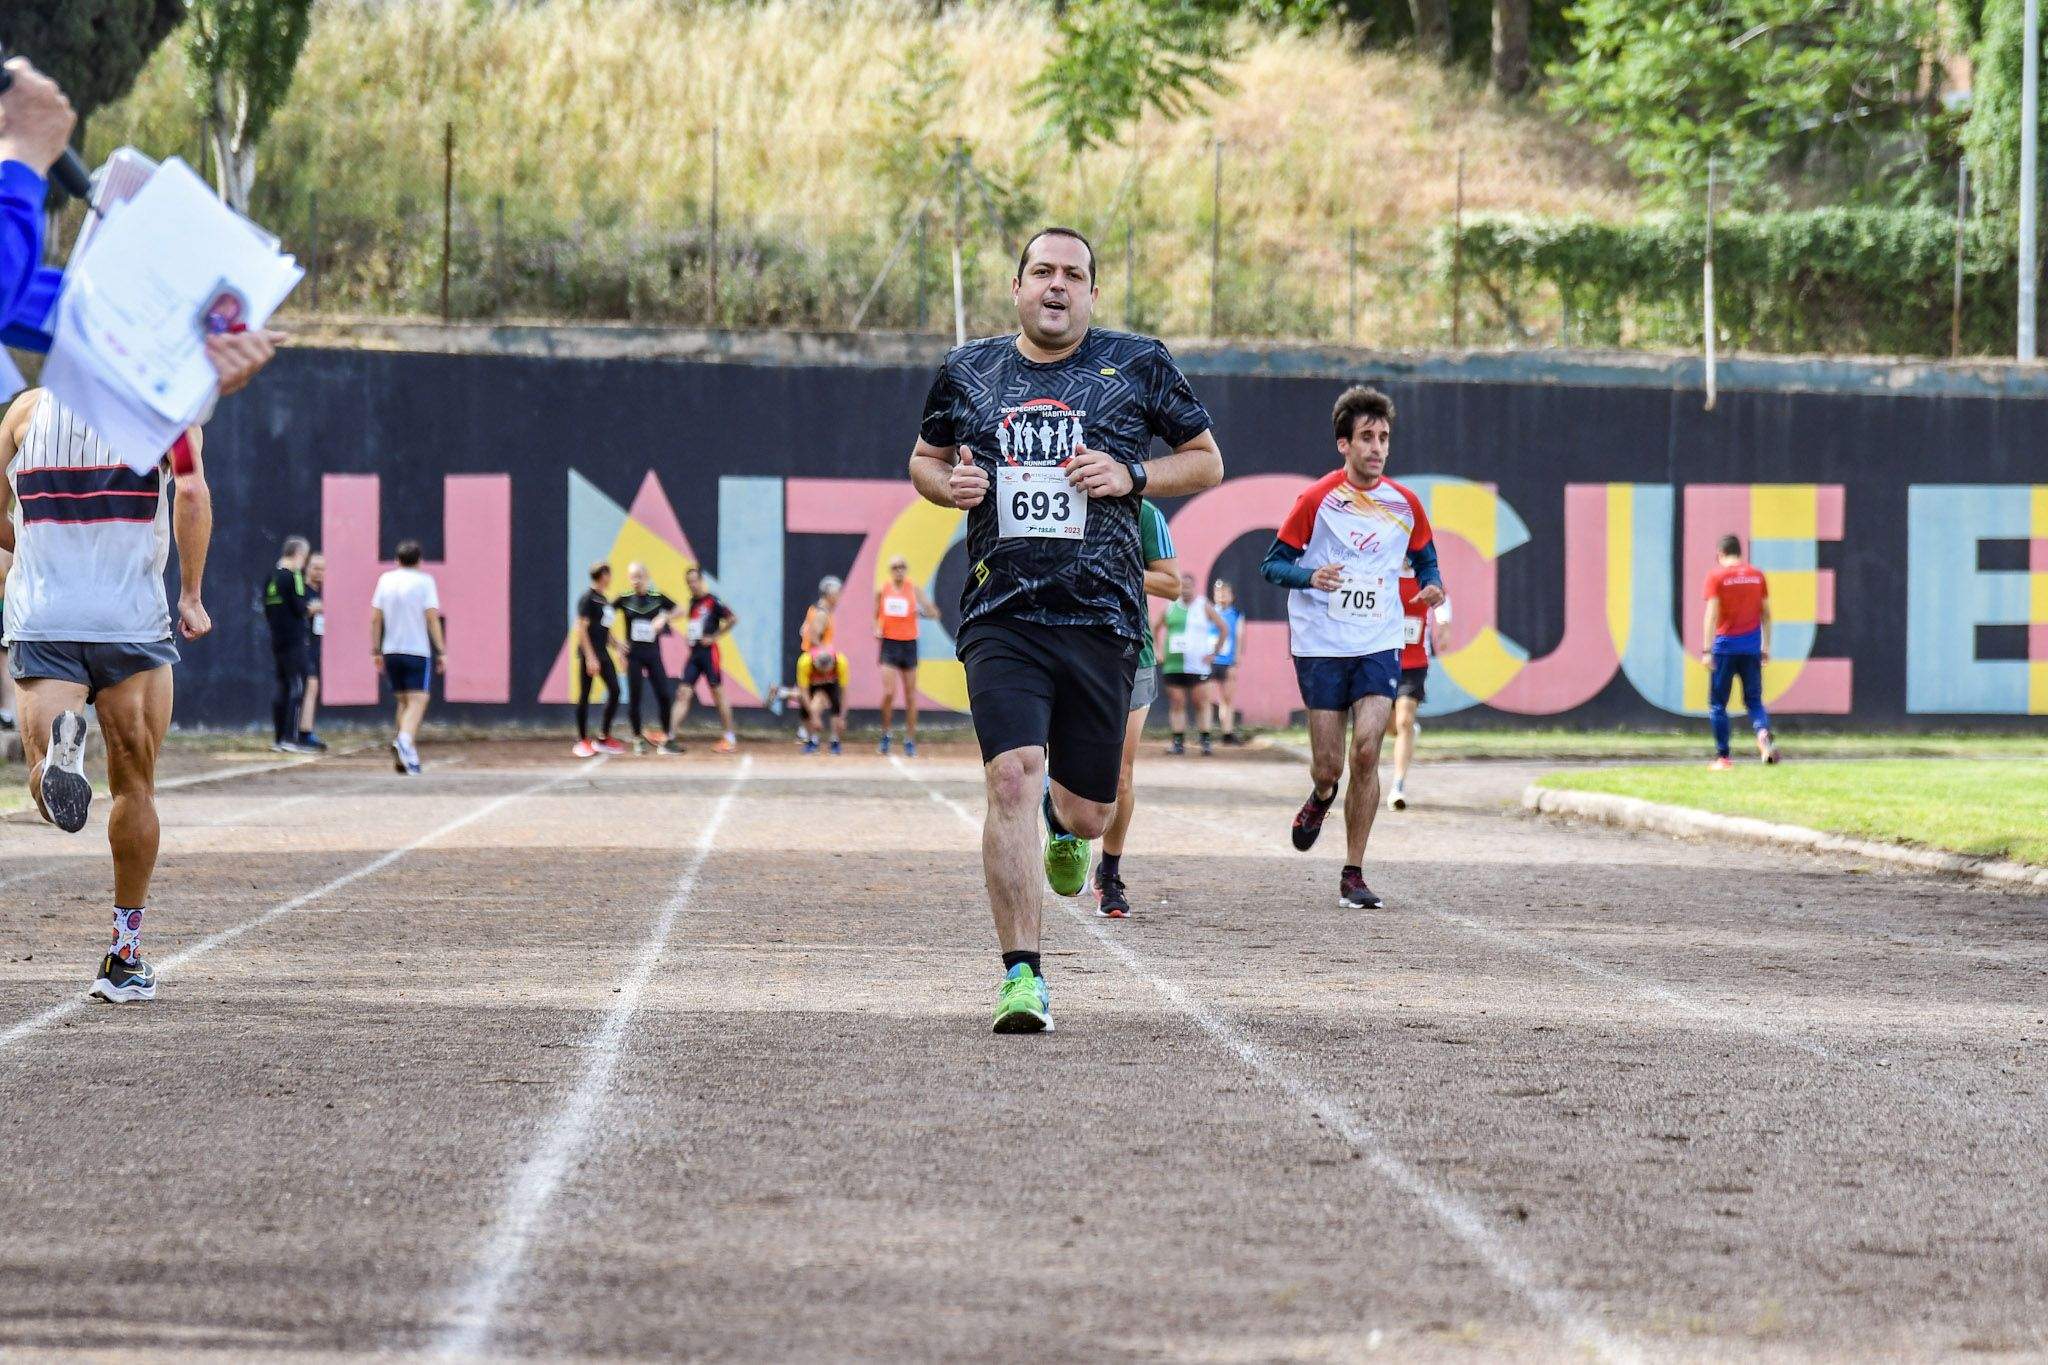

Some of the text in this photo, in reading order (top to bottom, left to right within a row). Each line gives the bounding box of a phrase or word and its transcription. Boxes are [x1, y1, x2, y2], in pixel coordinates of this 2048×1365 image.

[1000, 404, 1053, 414] SOSPECHOSOS
[1042, 410, 1087, 418] HABITUALES
[1023, 459, 1057, 467] RUNNERS
[1012, 491, 1071, 522] 693
[1340, 590, 1376, 610] 705
